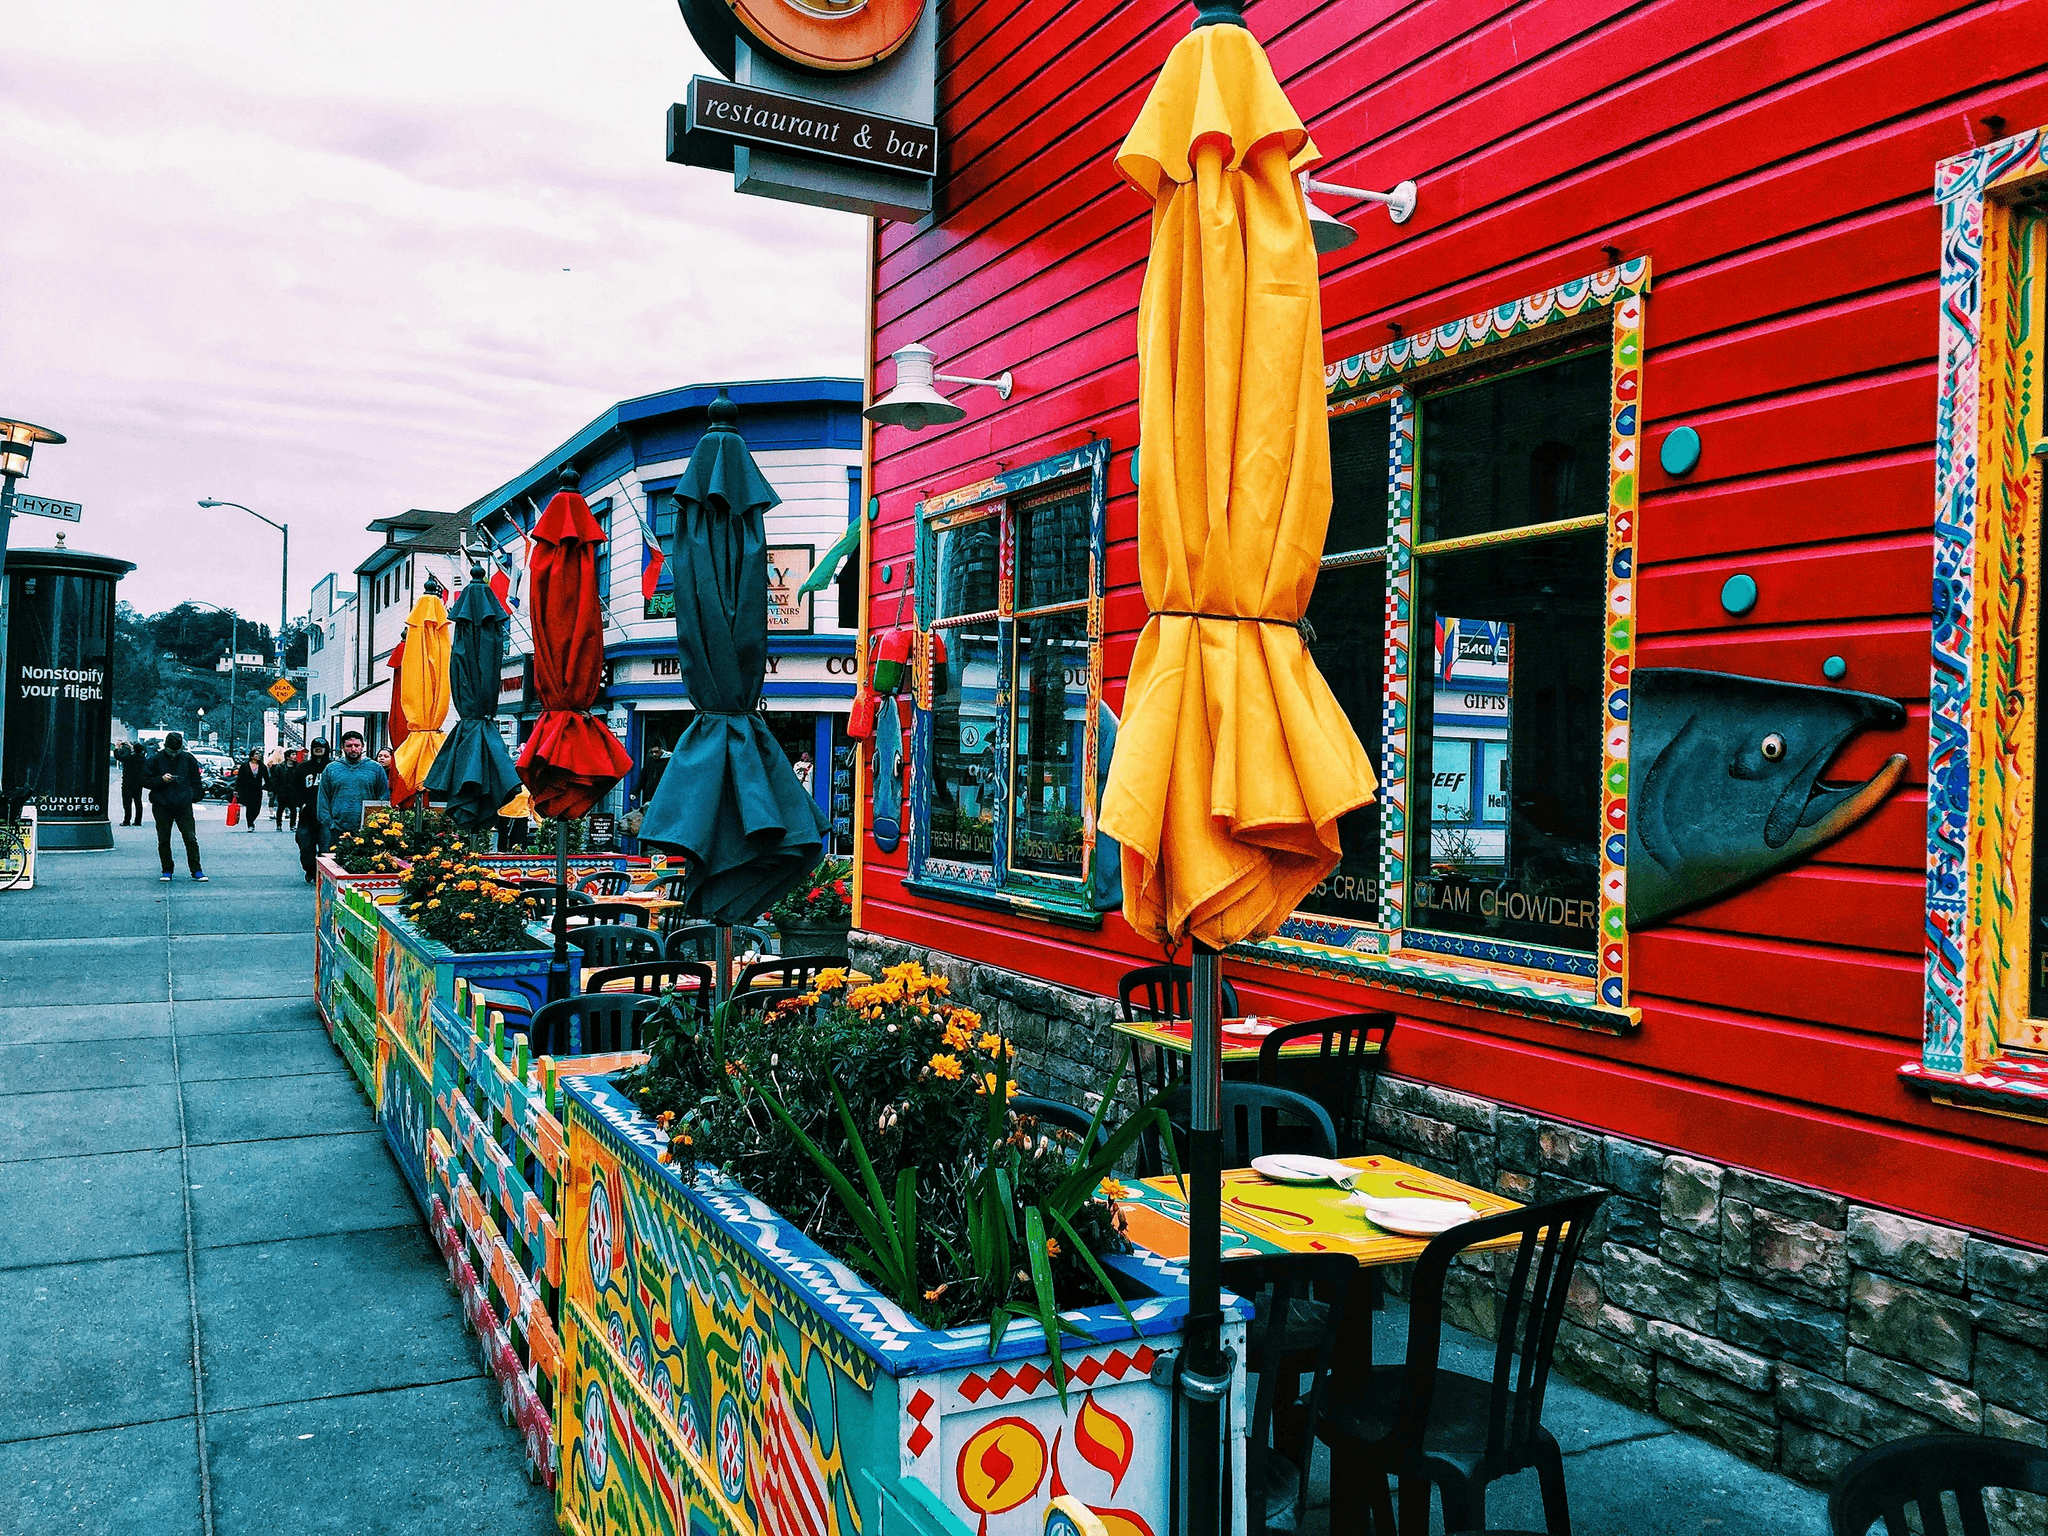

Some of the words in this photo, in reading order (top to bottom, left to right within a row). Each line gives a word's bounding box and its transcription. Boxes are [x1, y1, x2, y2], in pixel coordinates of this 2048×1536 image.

[705, 98, 841, 142] restaurant
[853, 123, 873, 149] &
[886, 130, 929, 160] bar
[23, 498, 74, 517] HYDE
[21, 665, 104, 685] Nonstopify
[652, 658, 680, 675] THE
[21, 685, 60, 698] your
[64, 684, 103, 701] flight.
[1464, 693, 1505, 710] GIFTS
[49, 796, 94, 804] UNITED
[930, 830, 954, 849] FRESH
[1334, 875, 1377, 903] CRAB
[1413, 882, 1470, 913] CLAM
[1479, 889, 1596, 930] CHOWDER
